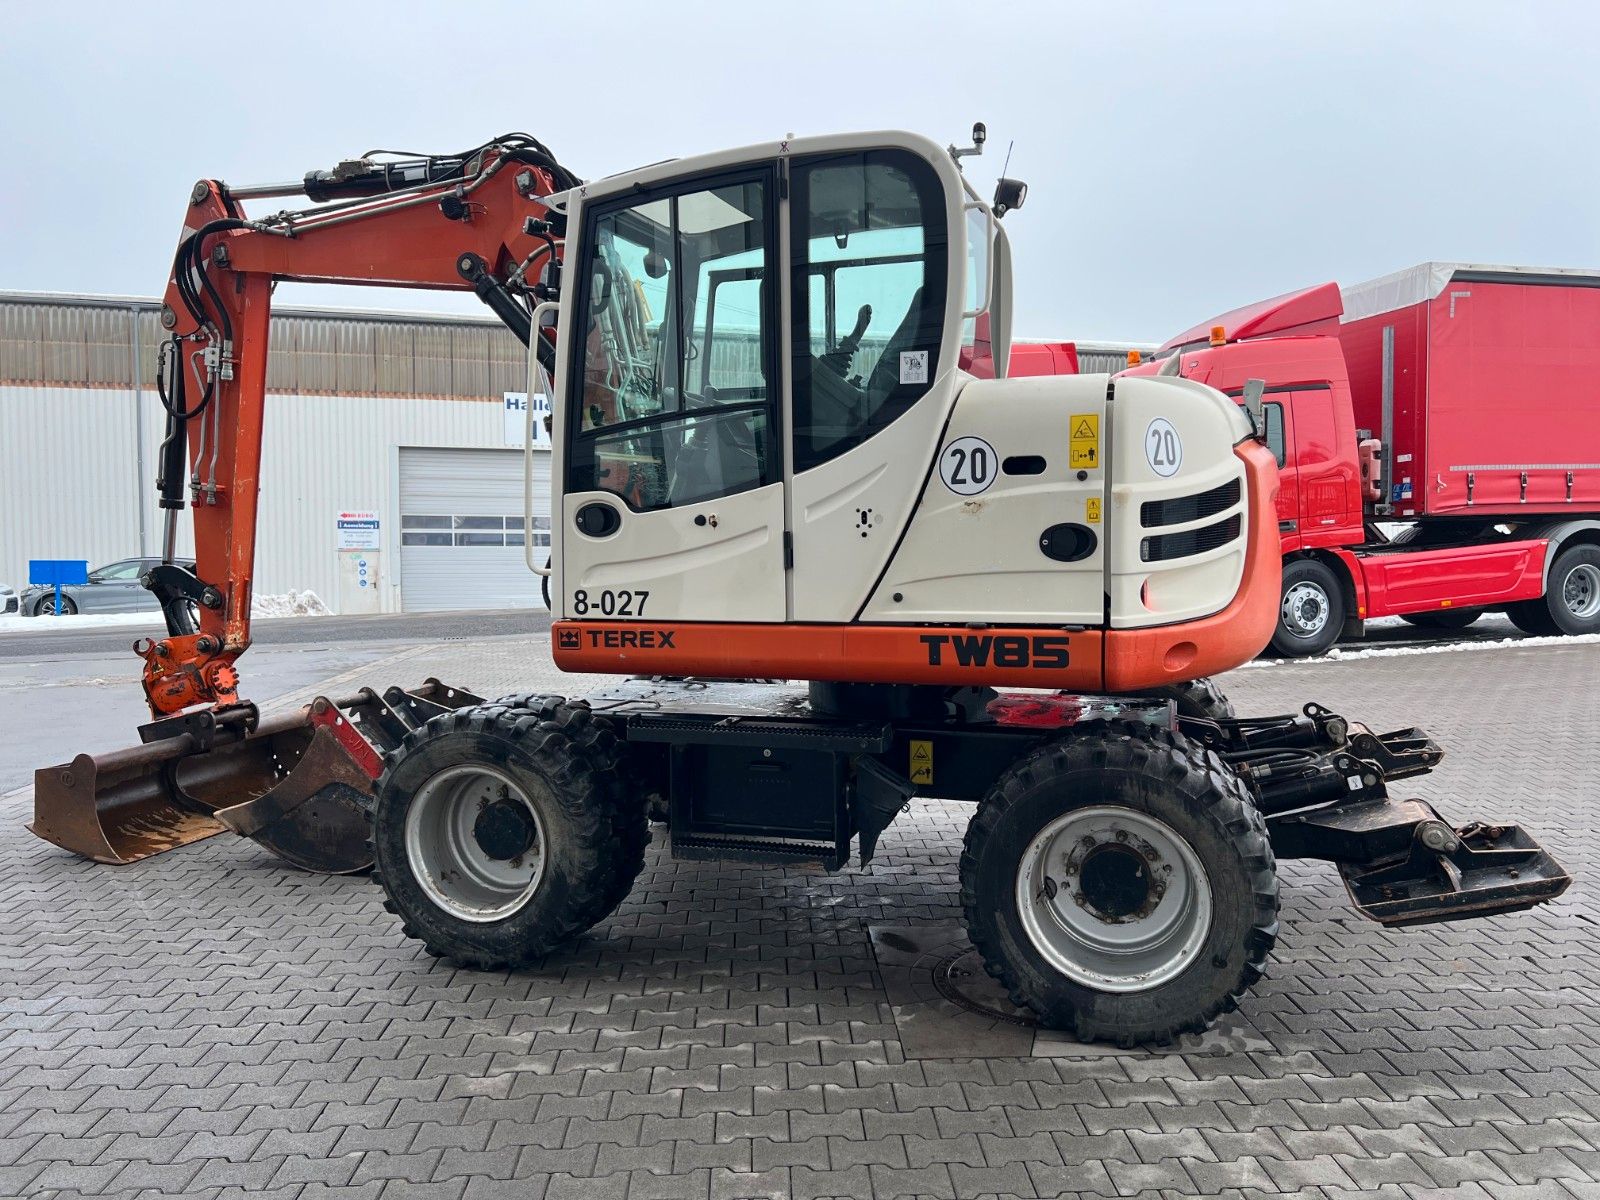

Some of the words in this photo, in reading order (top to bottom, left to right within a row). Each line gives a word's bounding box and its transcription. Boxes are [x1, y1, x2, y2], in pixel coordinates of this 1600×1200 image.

[1152, 429, 1176, 466] 20
[950, 447, 987, 485] 20
[574, 589, 650, 616] 8-027
[586, 630, 676, 648] TEREX
[919, 635, 1070, 668] TW85
